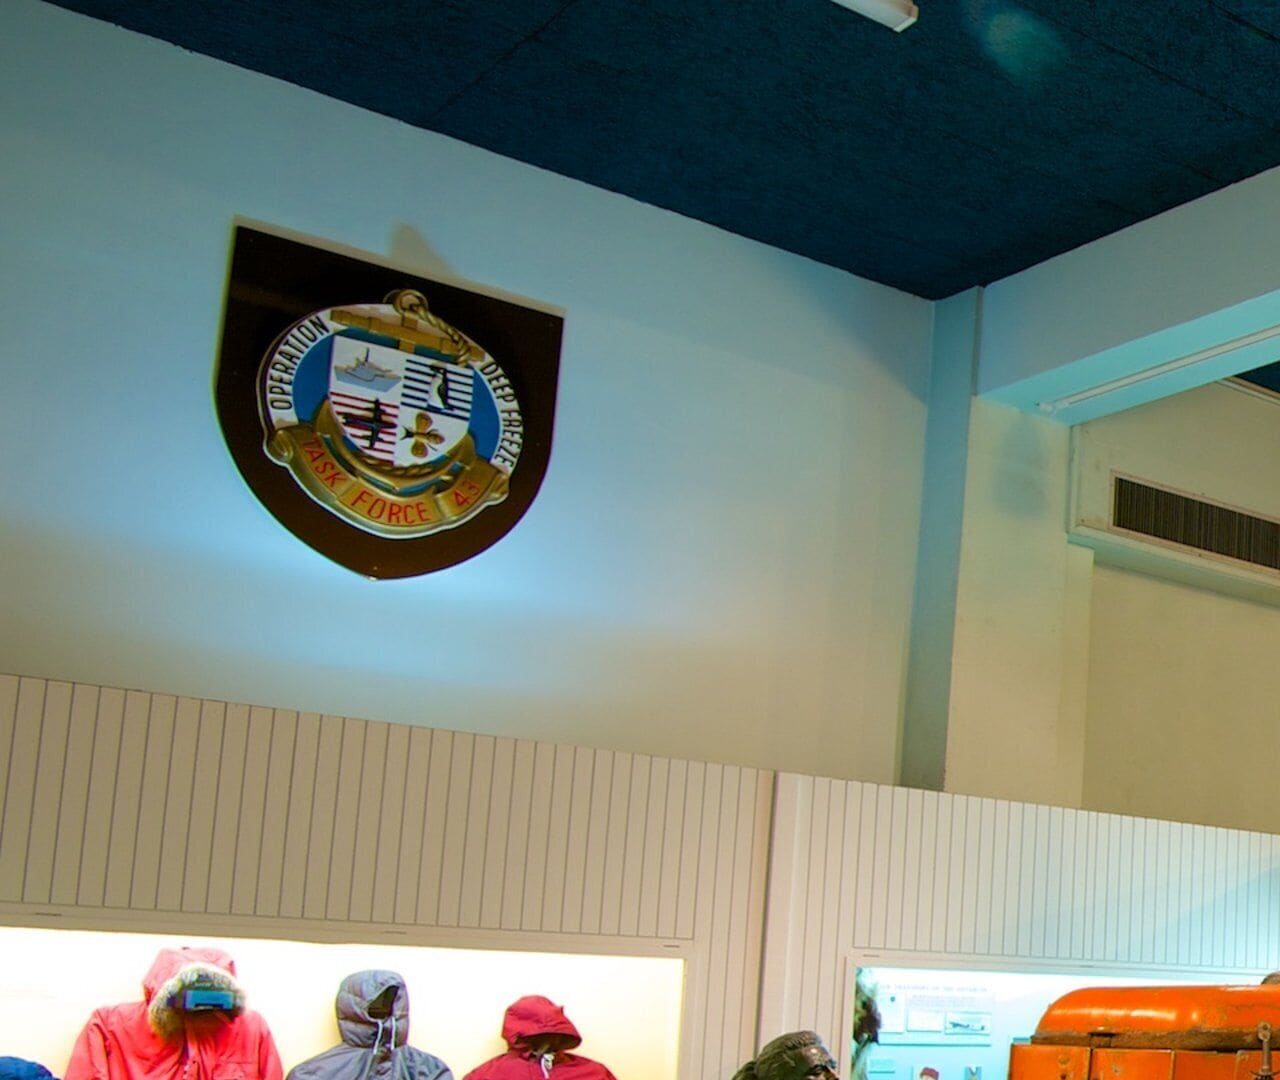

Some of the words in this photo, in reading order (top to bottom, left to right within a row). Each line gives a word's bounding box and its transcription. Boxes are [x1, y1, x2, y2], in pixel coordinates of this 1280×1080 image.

[270, 315, 330, 411] OPERATION
[482, 361, 516, 402] DEEP
[494, 409, 523, 468] FREEZE
[303, 437, 347, 489] TASK
[351, 490, 431, 524] FORCE
[452, 480, 480, 506] 43
